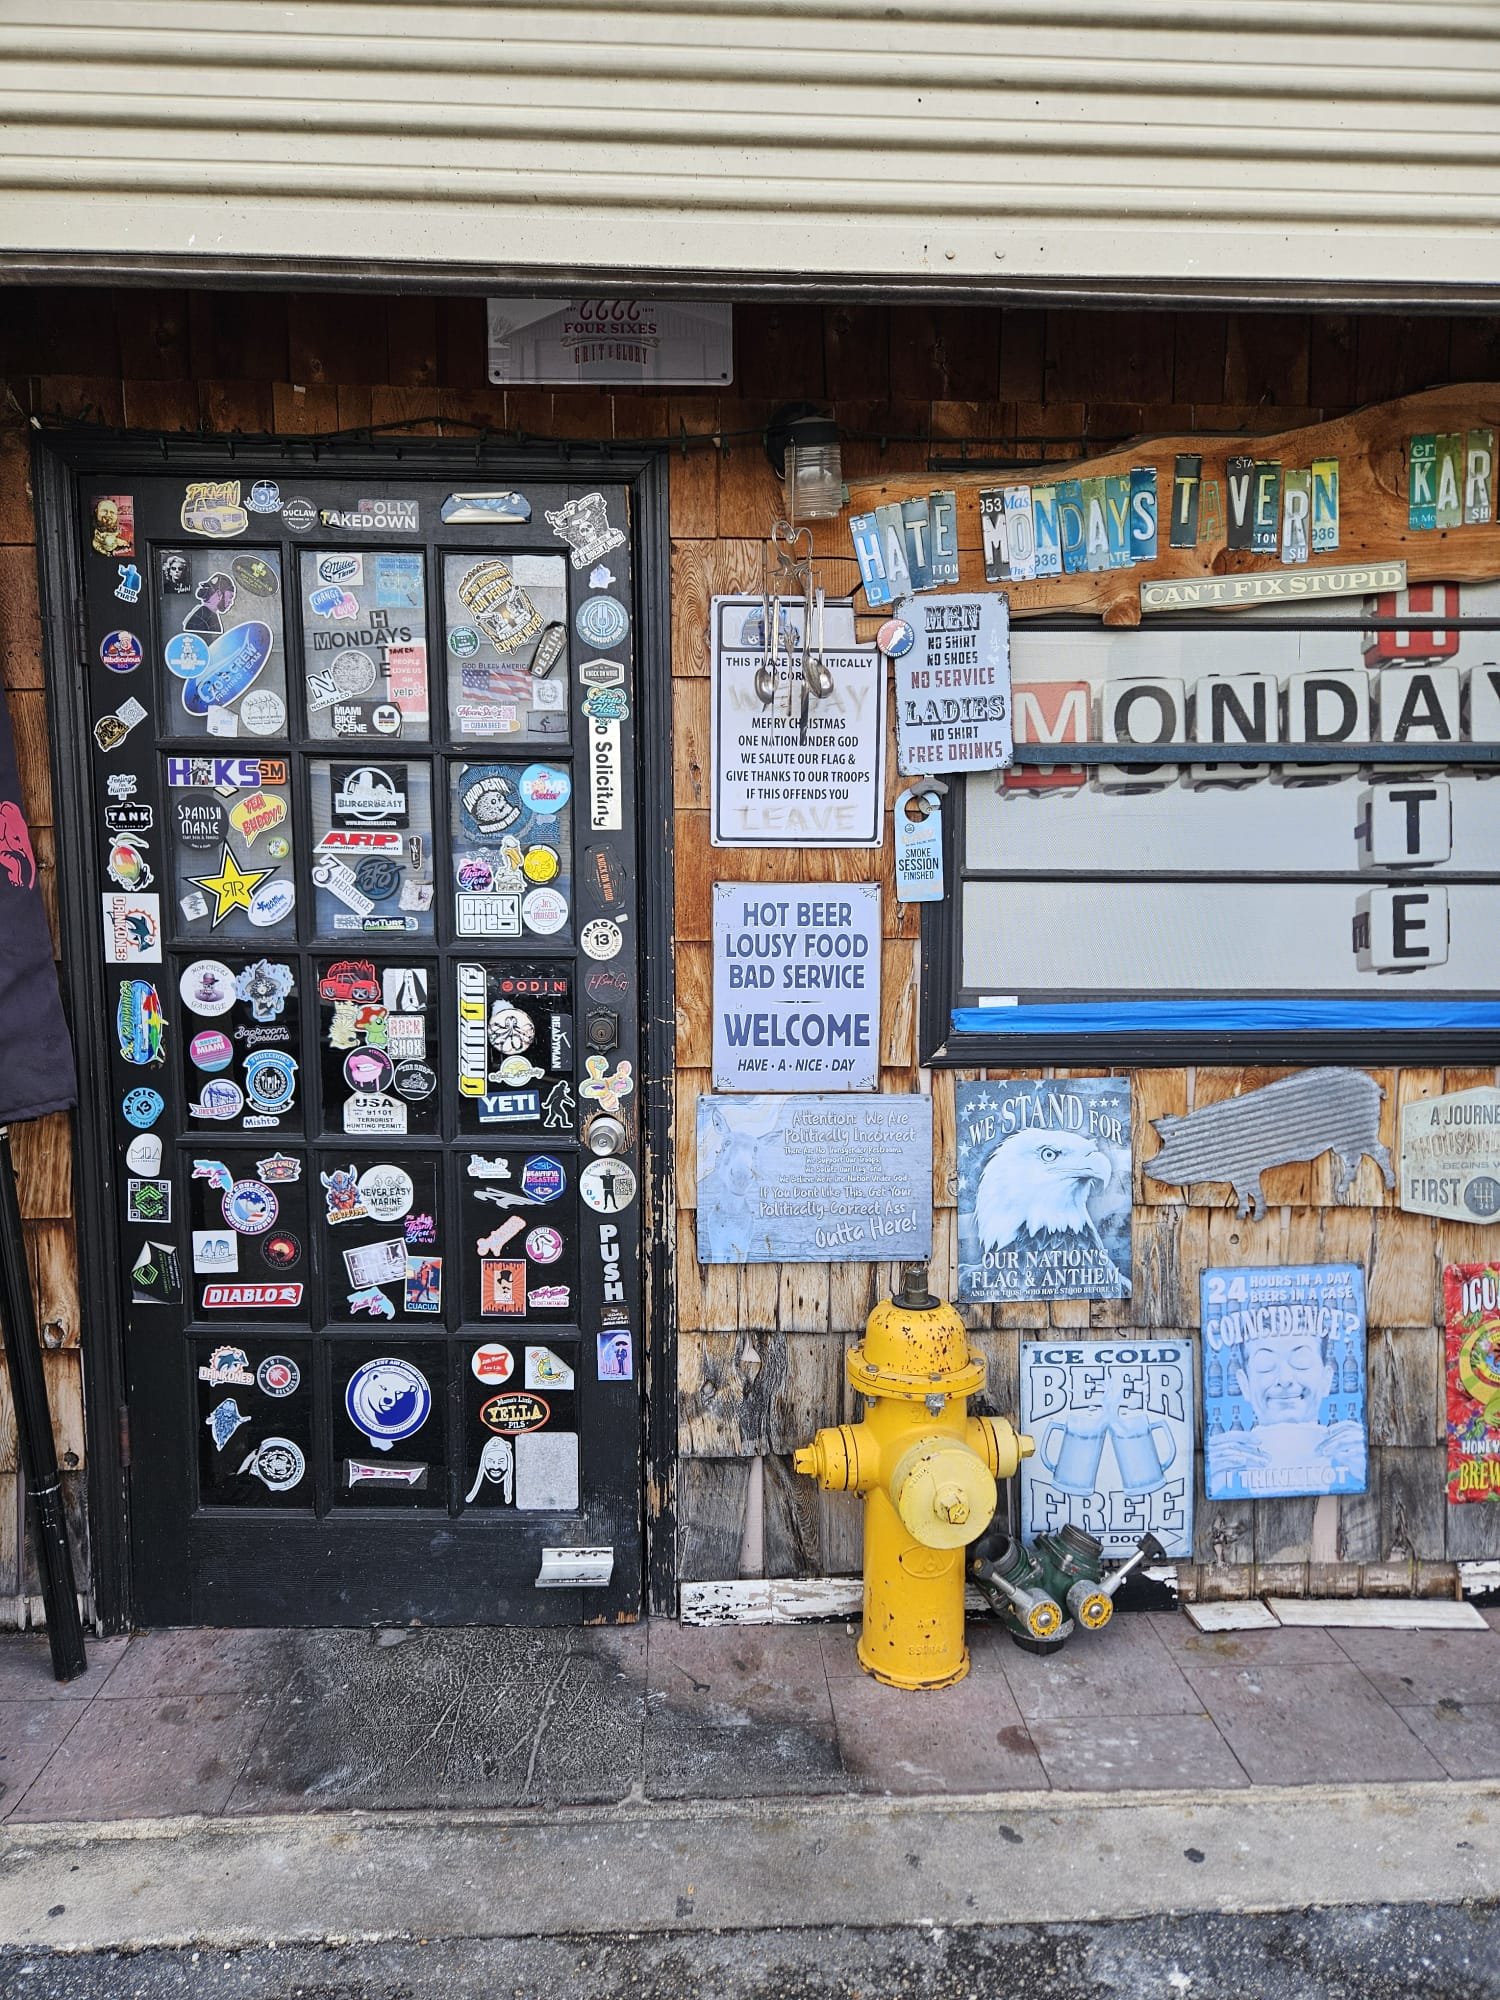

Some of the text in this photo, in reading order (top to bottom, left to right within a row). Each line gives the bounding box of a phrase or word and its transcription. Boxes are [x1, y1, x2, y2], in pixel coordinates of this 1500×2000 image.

[564, 323, 657, 334] FOUR SIXES
[574, 342, 648, 364] GRIT GLORY
[282, 508, 317, 518] DUCLAW
[320, 510, 417, 530] TAKEDOWN
[857, 502, 953, 582] HATE
[981, 490, 1156, 565] MONDAYS
[124, 587, 136, 597] DID
[1145, 568, 1402, 606] CAN'T FIX STUPID
[313, 589, 339, 606] CHANGE
[522, 613, 544, 637] NEVER
[924, 604, 982, 633] MEN
[313, 626, 412, 651] MONDAYS
[928, 635, 942, 650] NO
[945, 634, 976, 649] SHIRT
[243, 652, 263, 675] TEAM
[726, 657, 751, 667] THIS
[927, 650, 978, 666] NO SHOES
[911, 667, 995, 689] NO SERVICE
[393, 687, 414, 698] yelp
[334, 706, 362, 716] MIAMI
[905, 694, 1006, 726] LADIES
[334, 715, 356, 724] BIKE
[752, 717, 846, 730] MERRY CHISTMAS
[334, 723, 368, 734] SCENE
[930, 726, 979, 741] NO SHIRT
[738, 735, 759, 747] ONE
[761, 735, 801, 747] NATION
[837, 735, 859, 748] GOD
[741, 753, 856, 764] WE SALUTE OUR FLAG &
[908, 740, 1003, 764] FREE DRINKS
[593, 740, 614, 827] Soliciting
[726, 771, 870, 783] GIVE THANKS TO OUR TROOPS
[746, 788, 849, 800] IF THIS OFFENDS YOU
[107, 811, 150, 822] TANK
[177, 804, 222, 820] SPANISH
[181, 819, 220, 835] MARIE
[322, 832, 399, 847] ARP
[905, 848, 931, 858] SMOKE
[898, 858, 939, 871] SESSION
[904, 871, 934, 881] FINISHED
[332, 876, 374, 913] HERITAGE
[743, 902, 852, 928] HOT BEER
[112, 896, 128, 961] DRINKONES
[583, 921, 620, 938] MAGIC
[594, 934, 610, 946] 13
[725, 933, 869, 958] LOUSY FOOD
[729, 965, 864, 989] BAD SERVICE
[234, 1026, 287, 1039] Backroom
[390, 1019, 421, 1036] ROCK
[723, 1013, 870, 1047] WELCOME
[196, 1041, 227, 1055] MIAMI
[552, 1015, 561, 1070] READYMAN
[738, 1058, 855, 1072] HAVE A NICE DAY
[124, 1089, 155, 1115] MAGIC
[135, 1100, 152, 1115] 13
[216, 1104, 239, 1114] ESTATE
[355, 1098, 394, 1108] USA
[481, 1094, 536, 1113] YETI
[244, 1117, 279, 1127] Mishto
[792, 1111, 909, 1128] Attention: We Are
[968, 1093, 1123, 1147] WE STAND FOR
[1430, 1105, 1440, 1126] A
[784, 1128, 917, 1146] Politically Incorrect
[1442, 1162, 1489, 1170] BEGINS
[360, 1187, 411, 1197] NEVER EASY
[760, 1185, 912, 1198] If You Get Your
[1411, 1179, 1461, 1207] FIRST
[370, 1197, 403, 1206] MARINE
[885, 1201, 906, 1217] Ass
[815, 1209, 918, 1249] Outta Here!
[600, 1224, 625, 1301] PUSH
[982, 1248, 1110, 1270] OUR NATION'S
[971, 1267, 1120, 1289] FLAG & ANTHEM
[1250, 1272, 1351, 1288] HOURS IN A DAY
[209, 1288, 278, 1303] DIABLO
[970, 1286, 1111, 1297] AND WHO HAVE STOOD BEFORE
[1208, 1276, 1249, 1304] 24
[1250, 1285, 1353, 1303] BEERS IN A CASE
[1206, 1304, 1361, 1351] COINCIDENCE?
[1032, 1348, 1181, 1365] ICE COLD
[199, 1367, 254, 1384] DRINKONES
[1030, 1365, 1185, 1423] BEER
[487, 1404, 544, 1423] YELLA
[508, 1420, 527, 1429] PILS
[1030, 1477, 1185, 1533] FREE
